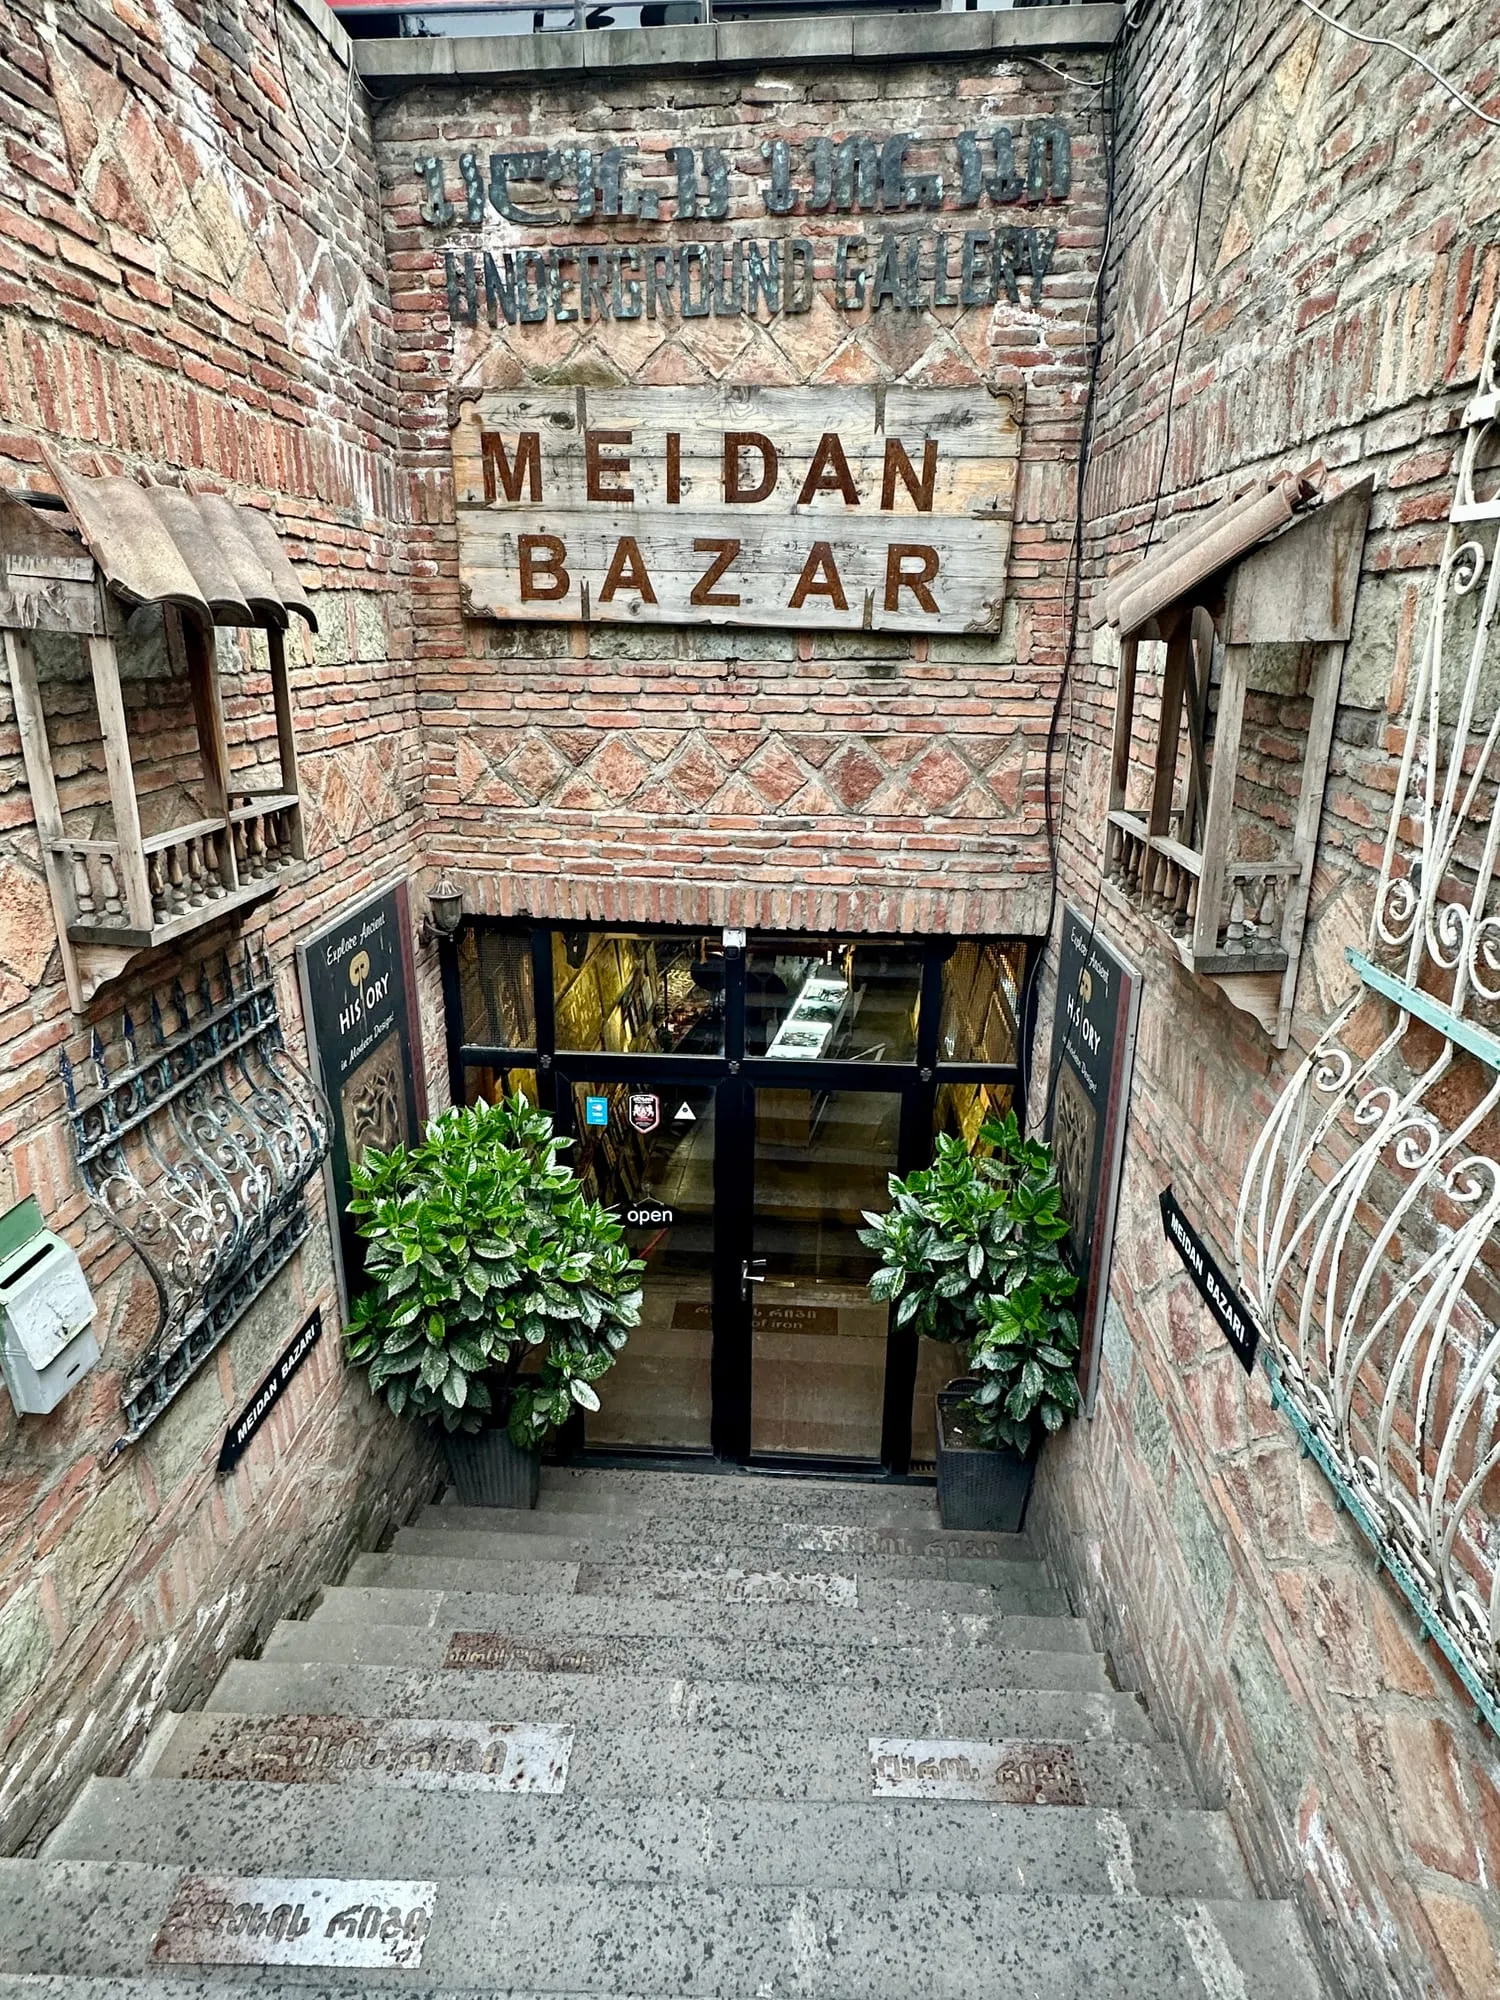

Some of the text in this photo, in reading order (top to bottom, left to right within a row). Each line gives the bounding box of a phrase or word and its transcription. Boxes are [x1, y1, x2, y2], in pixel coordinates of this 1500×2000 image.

[444, 227, 1058, 326] UNDERGROUND GALLERY
[480, 431, 940, 512] MEIDAN
[518, 534, 942, 614] BAZAR
[327, 911, 386, 966] Explore Ancient
[348, 1032, 374, 1067] Modern
[627, 1209, 673, 1226] open
[1170, 1212, 1246, 1344] MEIDAN BAZARI
[772, 1320, 803, 1330] iron
[237, 1324, 315, 1443] MEIDAN BAZARI
